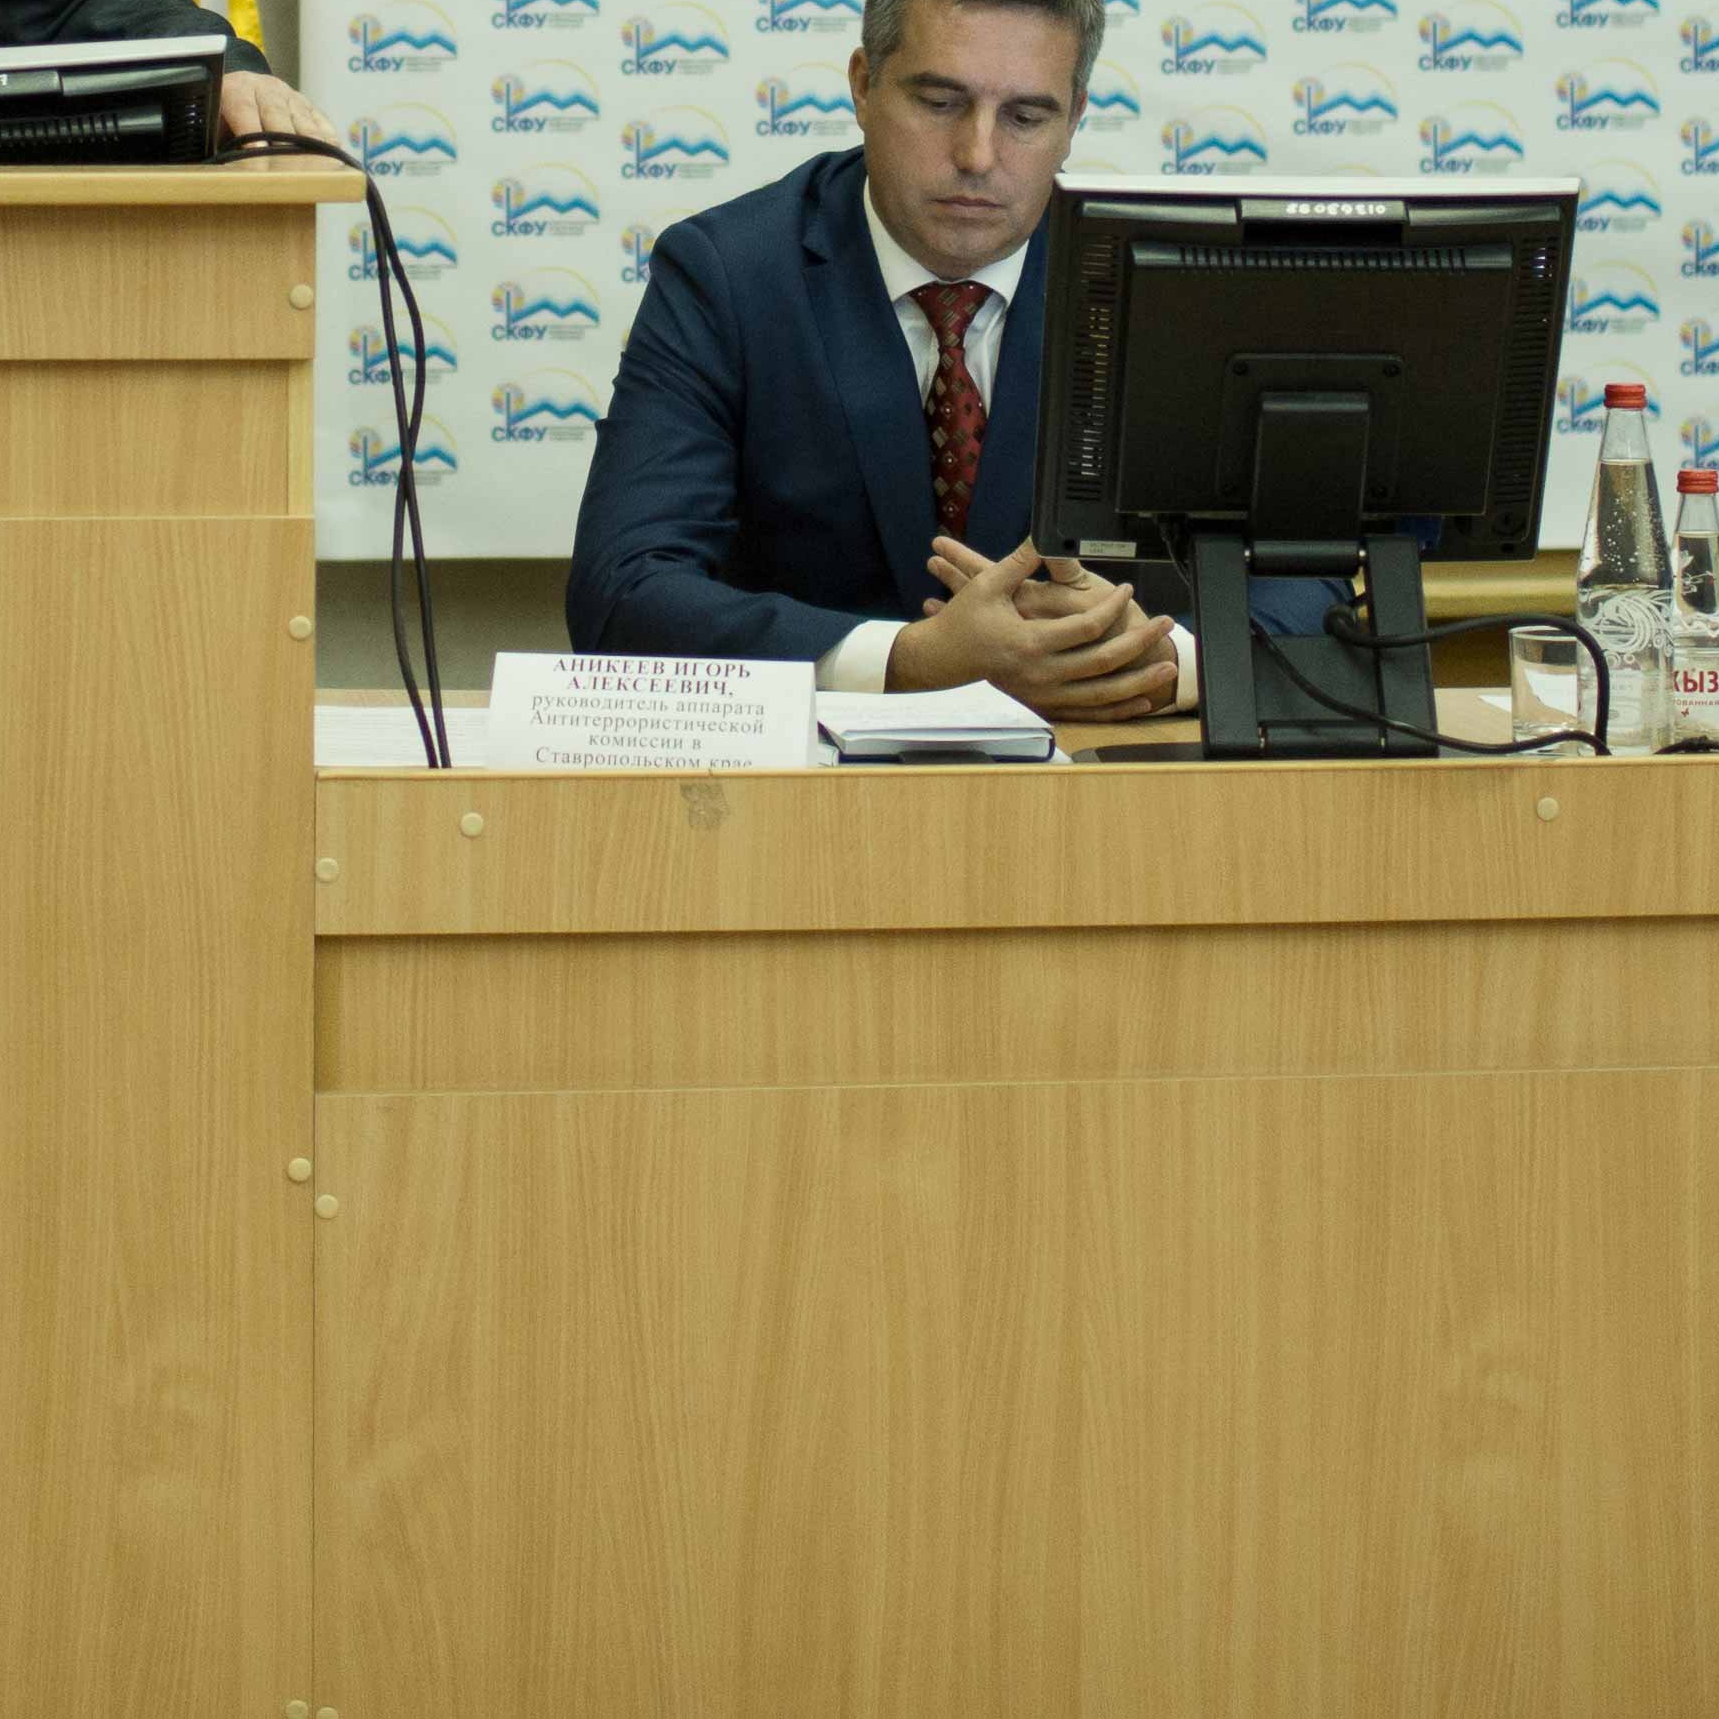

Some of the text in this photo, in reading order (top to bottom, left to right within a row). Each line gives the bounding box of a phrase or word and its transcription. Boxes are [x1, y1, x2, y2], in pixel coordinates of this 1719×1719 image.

[492, 12, 547, 27] СКФУ
[756, 16, 811, 31] СКФУ
[349, 56, 404, 71] СКФУ
[622, 59, 677, 74] СКФУ
[492, 116, 547, 131] СКФУ
[756, 121, 809, 135] СКФУ
[1293, 120, 1346, 134] СКФУ
[1556, 115, 1609, 129] СКФУ
[622, 162, 677, 177] СКФУ
[1419, 158, 1472, 172] СКФУ
[492, 220, 547, 235] СКФУ
[492, 324, 547, 339] СКФУ
[492, 425, 547, 440] СКФУ
[552, 657, 752, 678] АНИКЕЕВ ИГОРЬ
[531, 695, 766, 718] руководитель аппарата
[530, 710, 765, 735] Антитеррористической
[587, 734, 702, 751] комиссии в
[535, 746, 701, 769] Ставропольском
